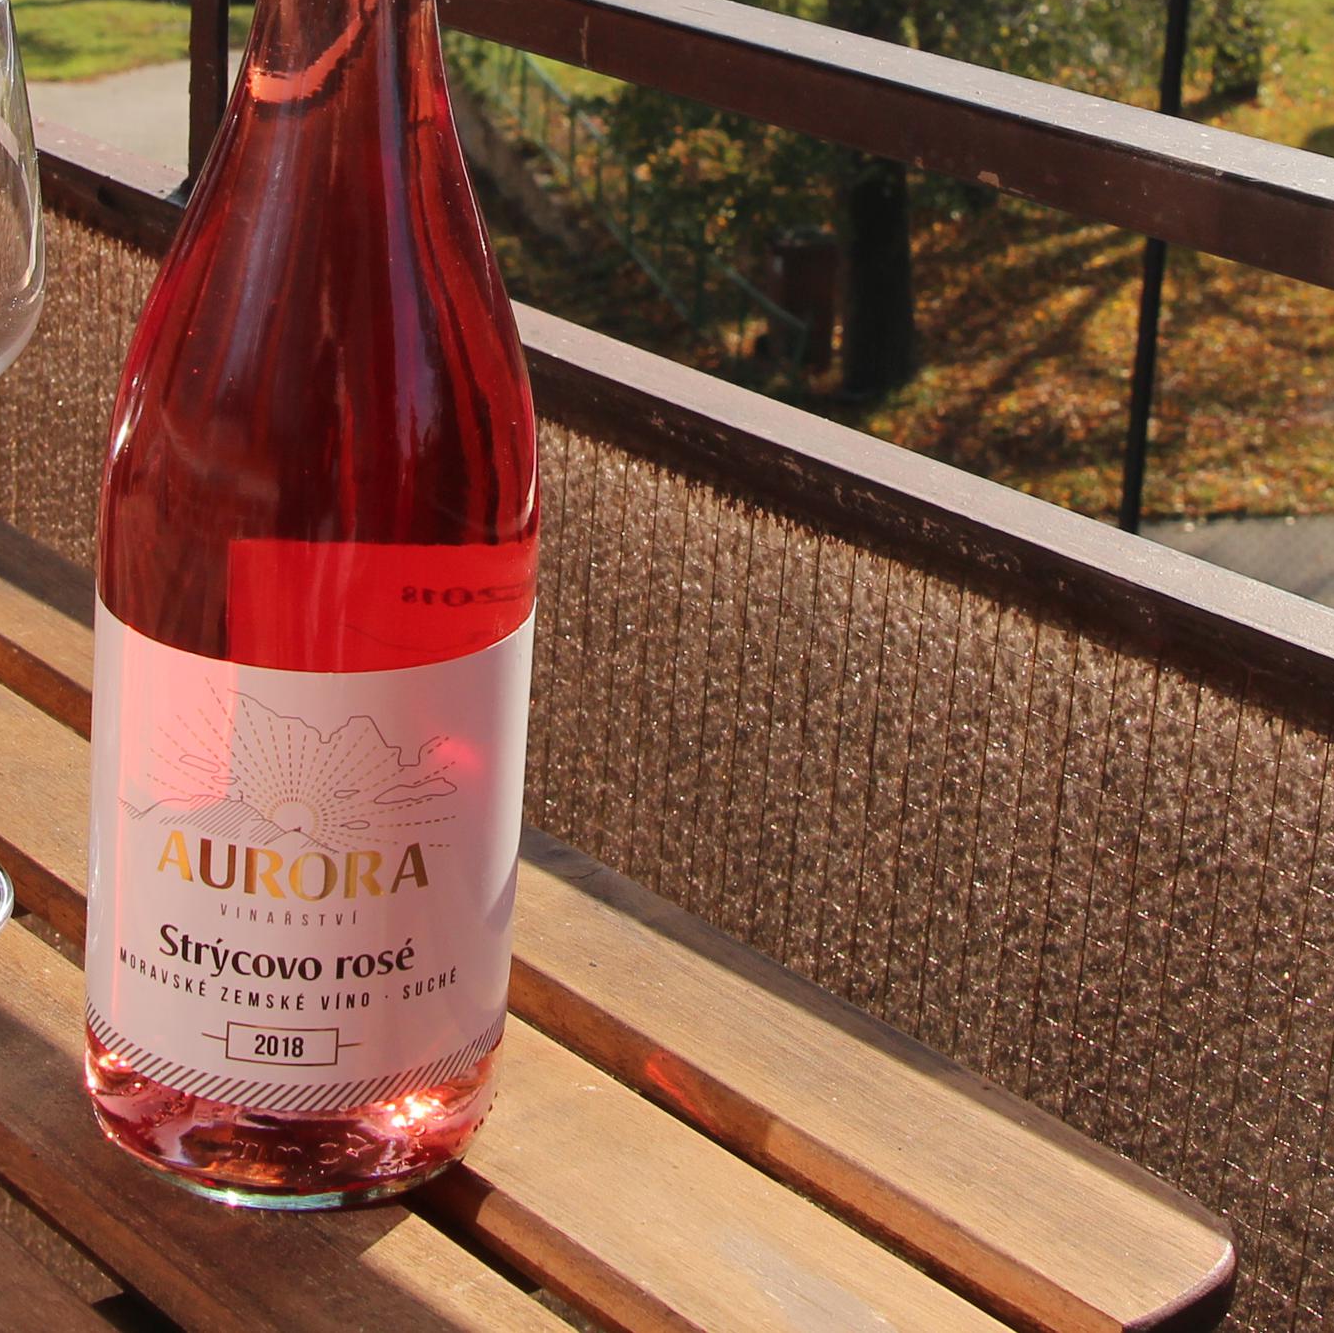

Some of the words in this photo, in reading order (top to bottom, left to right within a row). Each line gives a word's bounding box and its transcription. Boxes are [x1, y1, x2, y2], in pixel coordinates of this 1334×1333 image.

[157, 830, 429, 902] AURORA
[220, 902, 357, 926] VINAŘSTVÍ
[120, 946, 207, 997] MORAVSKÉ
[220, 986, 305, 1011] ZEMSKÉ
[321, 991, 370, 1011] VÍNO
[402, 966, 457, 1001] SUCHÉ
[159, 923, 323, 981] Strýcovo
[335, 937, 415, 980] rosé
[254, 1033, 304, 1058] 2018
